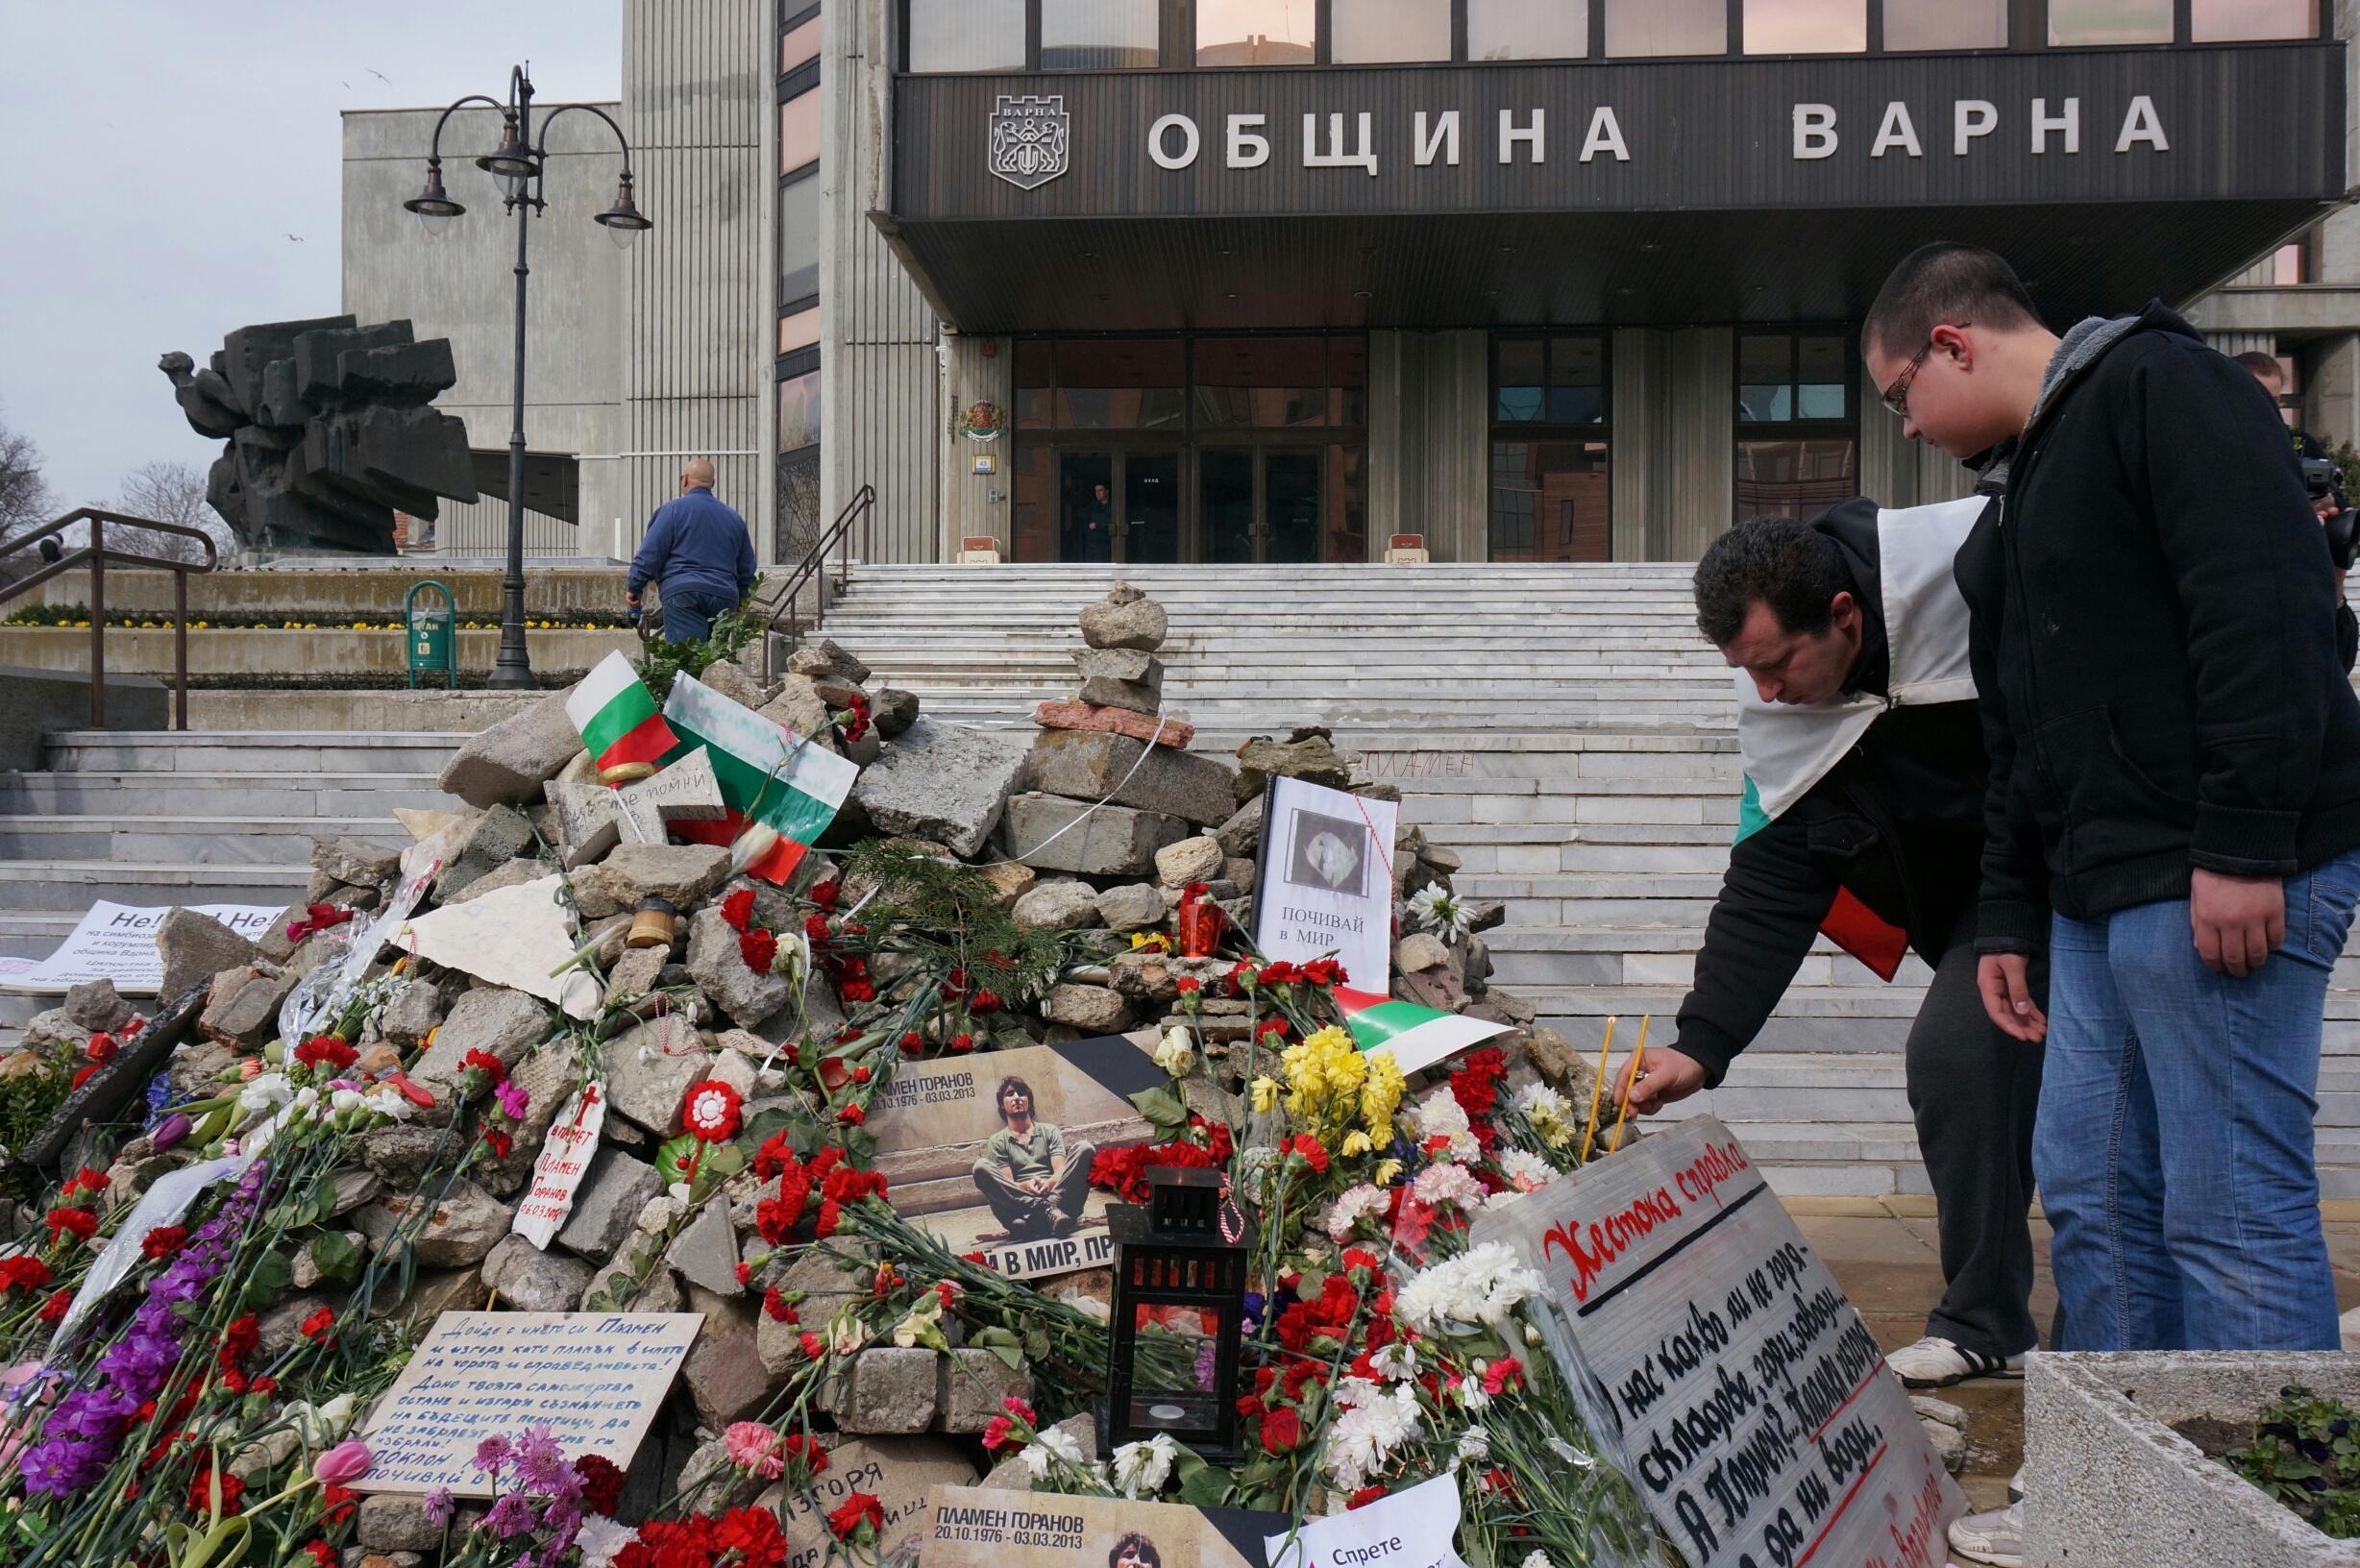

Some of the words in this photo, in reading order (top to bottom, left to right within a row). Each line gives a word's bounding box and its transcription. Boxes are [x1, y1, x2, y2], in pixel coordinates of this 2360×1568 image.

[1003, 108, 1056, 116] ВАРНА
[1147, 106, 1631, 178] ОБЩИНА
[1792, 95, 2170, 160] ВАРНА
[1365, 750, 1475, 777] ПЛАМЕН
[110, 912, 164, 928] Не!
[229, 912, 281, 928] Не!
[1282, 906, 1364, 933] ПОЧИВАЙ
[1280, 930, 1288, 940] в
[1296, 929, 1335, 946] МИР
[875, 1079, 917, 1096] АМЕН
[920, 1071, 973, 1092] ГОРАНОВ
[873, 1095, 918, 1111] 0.10.1976
[925, 1087, 976, 1103] 03.03.2013
[1543, 1188, 1683, 1302] Жестока
[1675, 1140, 1748, 1209] справка
[1004, 1251, 1020, 1275] В
[1025, 1241, 1080, 1271] МИР,
[1084, 1235, 1114, 1262] ПР
[441, 1316, 502, 1338] Дойде
[569, 1325, 588, 1334] си
[1617, 1354, 1664, 1420] нас
[1658, 1300, 1729, 1382] какво
[1727, 1286, 1752, 1330] ли
[1746, 1268, 1773, 1309] не
[408, 1375, 461, 1392] Дано
[1796, 1469, 1831, 1524] ни
[936, 1507, 1007, 1528] ПЛАМЕН
[1011, 1511, 1084, 1533] ГОРАНОВ
[1675, 1490, 1719, 1566] А
[935, 1526, 1002, 1543] 20.10.1976
[1015, 1531, 1083, 1549] 03.03.2013
[1332, 1536, 1403, 1566] Спрете
